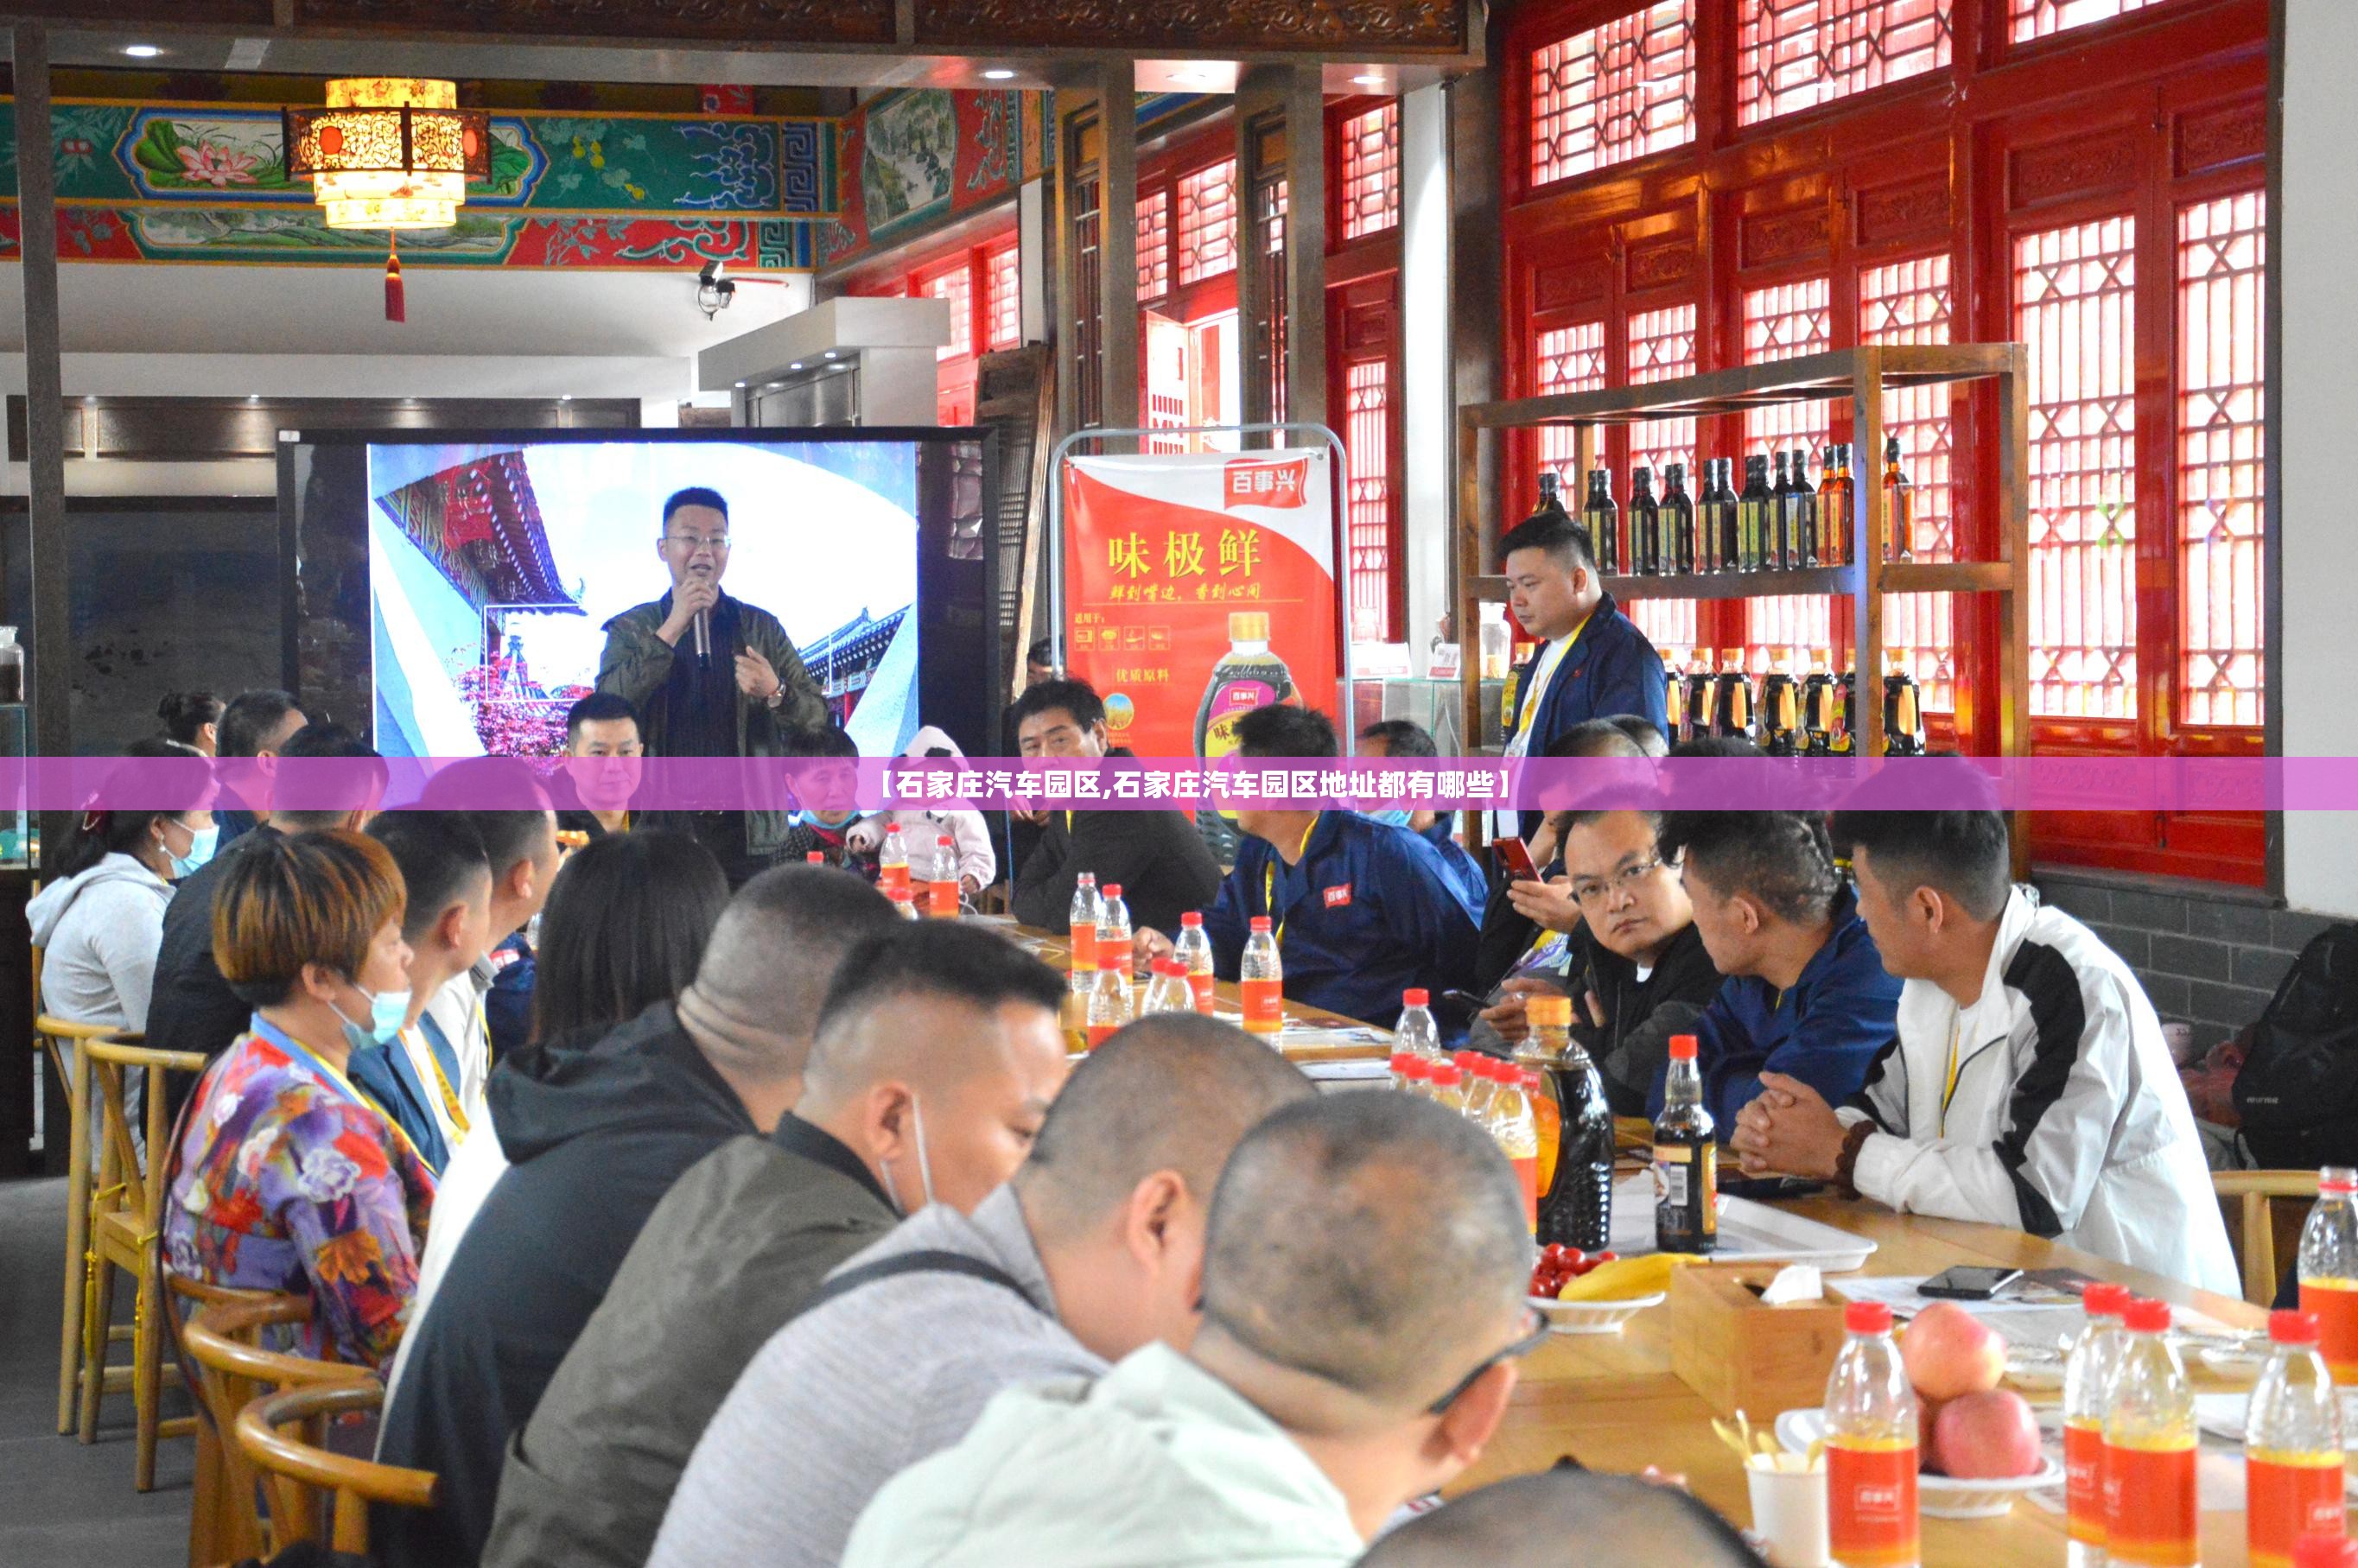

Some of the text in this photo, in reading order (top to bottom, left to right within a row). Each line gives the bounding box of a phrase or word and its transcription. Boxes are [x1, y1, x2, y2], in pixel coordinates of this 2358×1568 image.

[1232, 469, 1295, 493] 百事兴
[1109, 529, 1262, 580] 味极鲜
[1116, 668, 1169, 682] 优质原料
